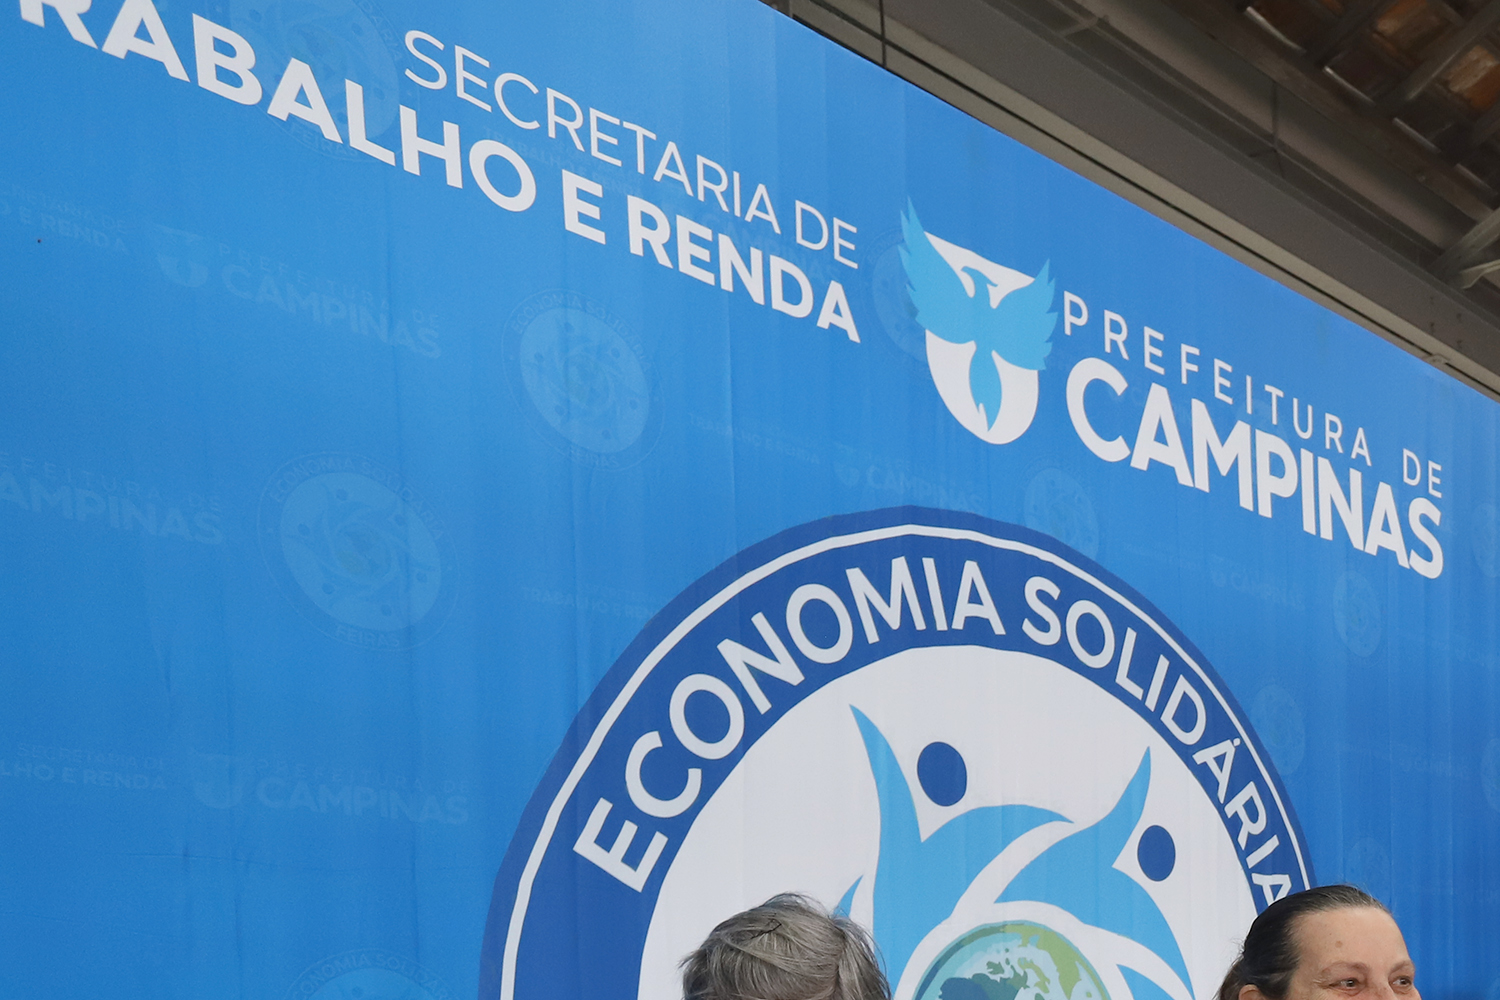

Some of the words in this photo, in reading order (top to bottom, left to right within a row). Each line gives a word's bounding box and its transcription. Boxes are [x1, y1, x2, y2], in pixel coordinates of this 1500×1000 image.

[403, 29, 782, 236] SECRETARIA
[794, 199, 860, 270] DE
[561, 168, 607, 246] E
[626, 193, 862, 344] RENDA
[1063, 289, 1373, 468] PREFEITURA
[1402, 447, 1443, 500] DE
[1065, 356, 1445, 580] CAMPINAS
[0, 470, 224, 546] AMPINAS
[572, 554, 1007, 893] ECONOMIA
[1021, 575, 1293, 908] SOLIDÁRIA
